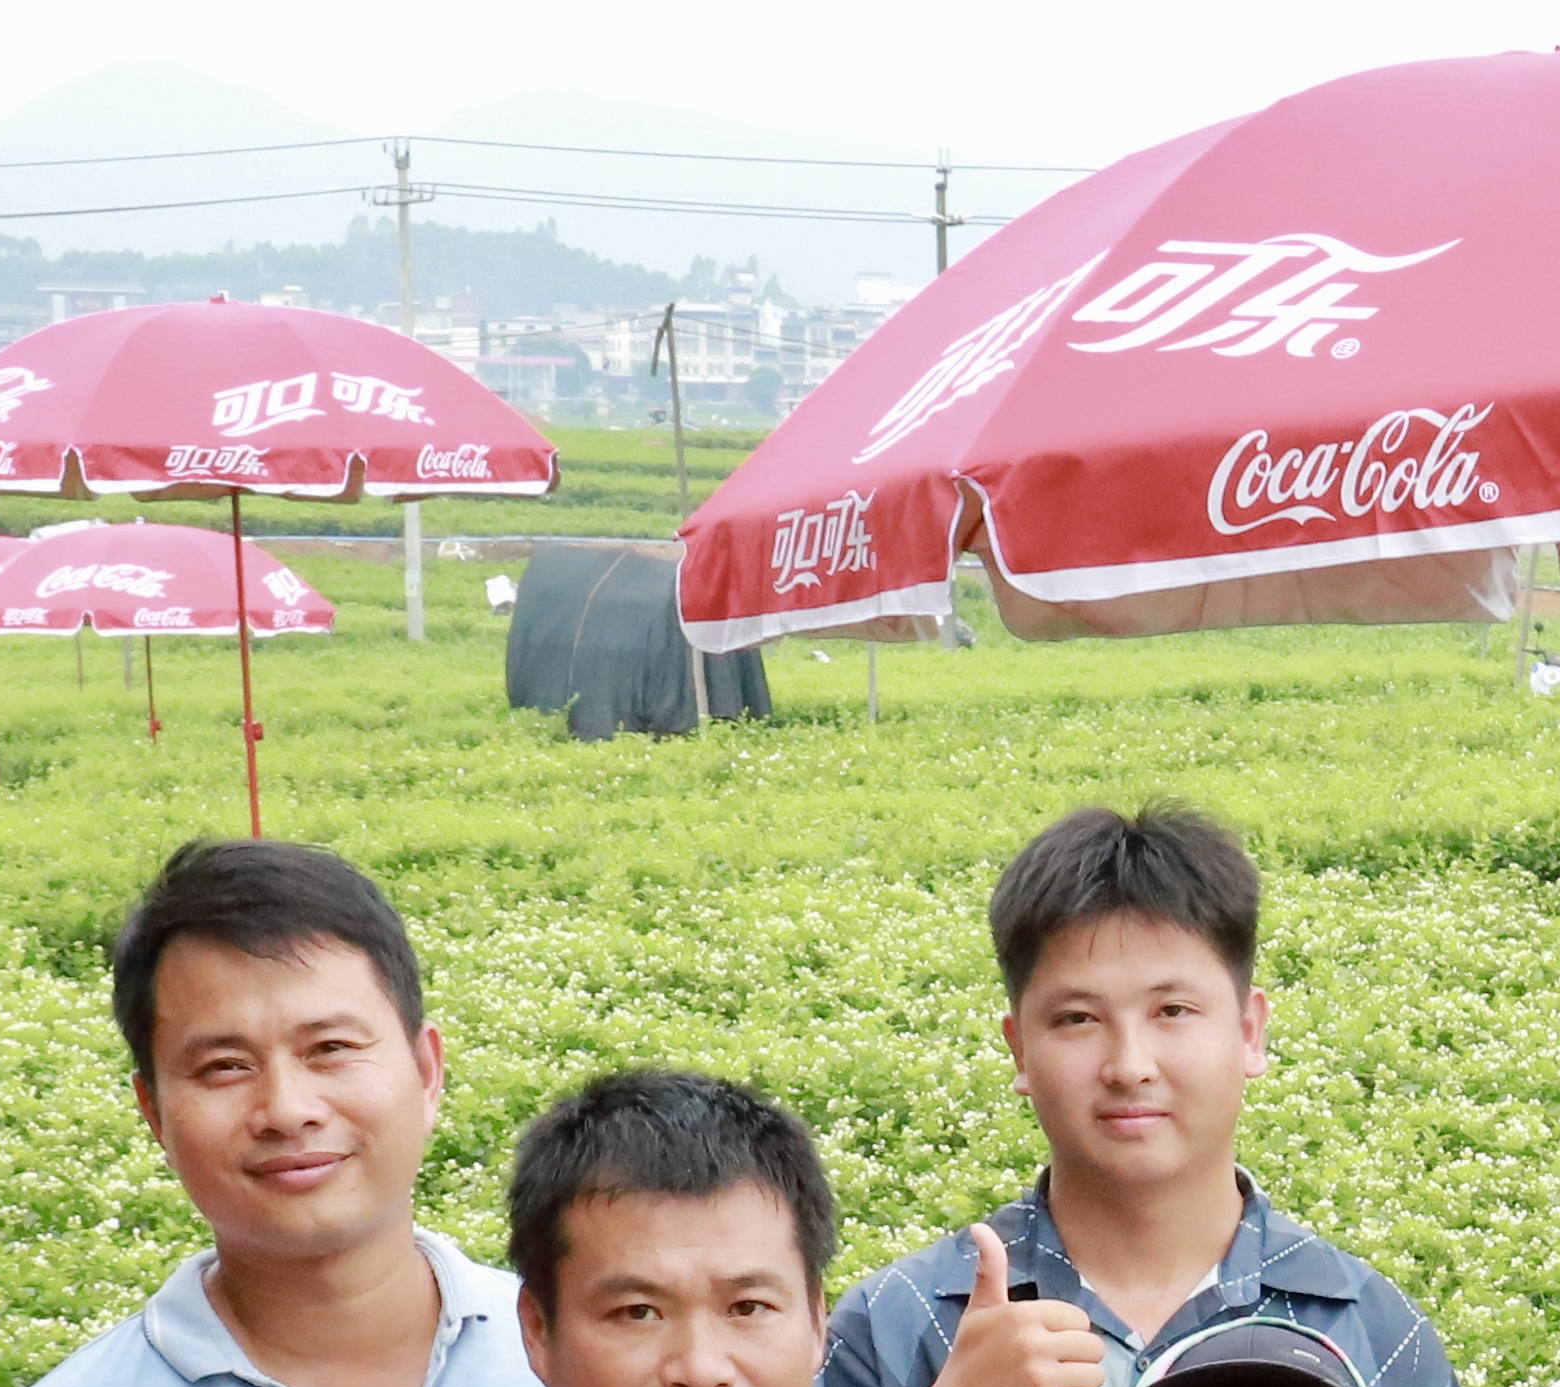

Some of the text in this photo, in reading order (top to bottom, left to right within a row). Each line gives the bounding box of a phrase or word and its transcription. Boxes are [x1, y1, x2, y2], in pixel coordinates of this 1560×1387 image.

[165, 444, 271, 476] 可口可乐
[1208, 402, 1494, 537] Coca-Cola
[771, 487, 877, 594] 可口可乐
